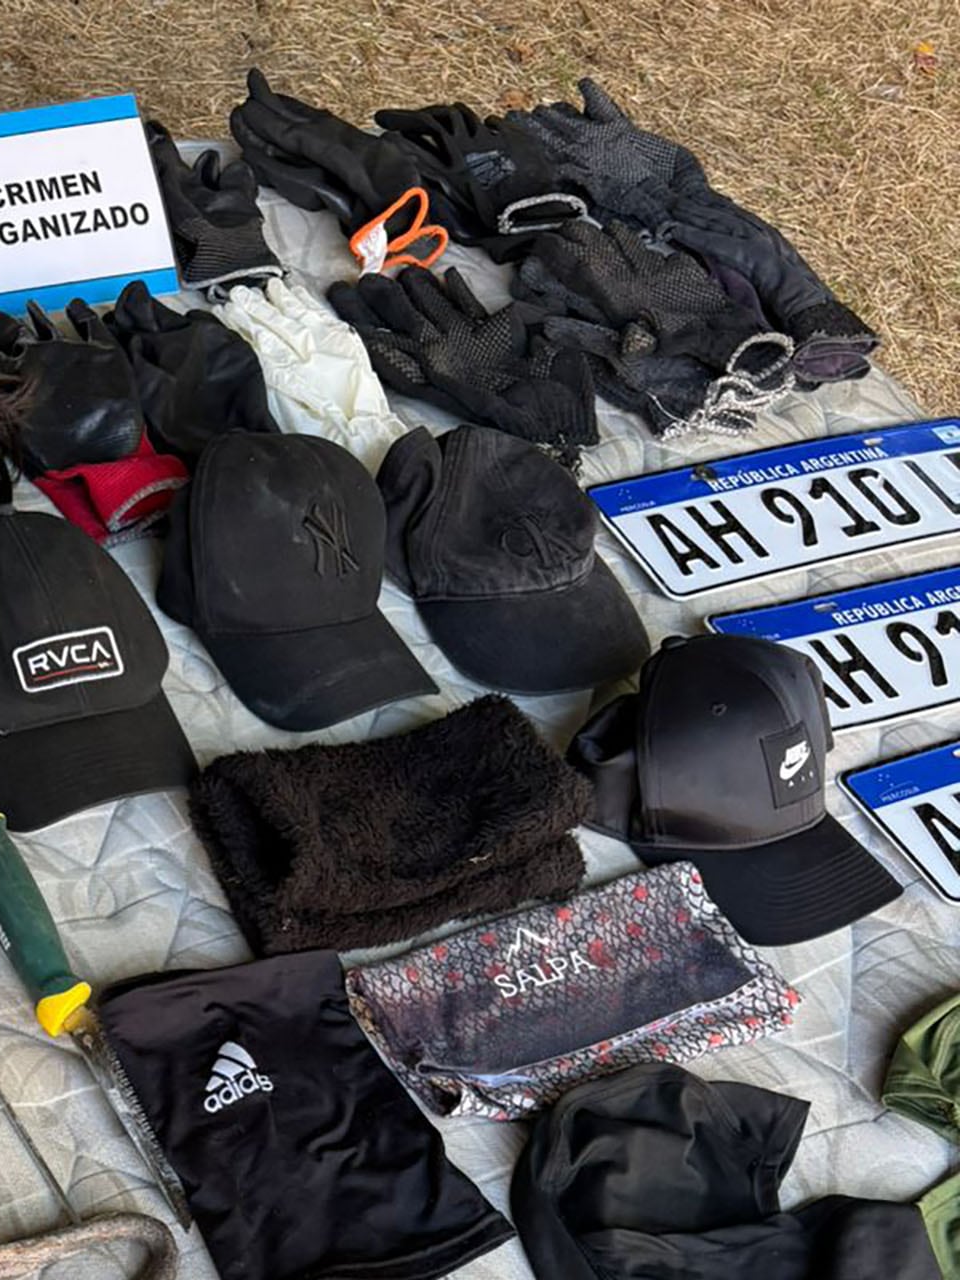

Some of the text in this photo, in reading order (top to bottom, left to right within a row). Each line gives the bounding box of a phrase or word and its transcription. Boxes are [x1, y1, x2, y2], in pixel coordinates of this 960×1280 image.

[707, 446, 889, 492] REPÚBLICA ARGENTINA
[645, 452, 960, 576] AH 910 L
[832, 596, 925, 626] REPÚBLICA
[27, 640, 111, 676] RVCA
[493, 950, 598, 998] SALPA
